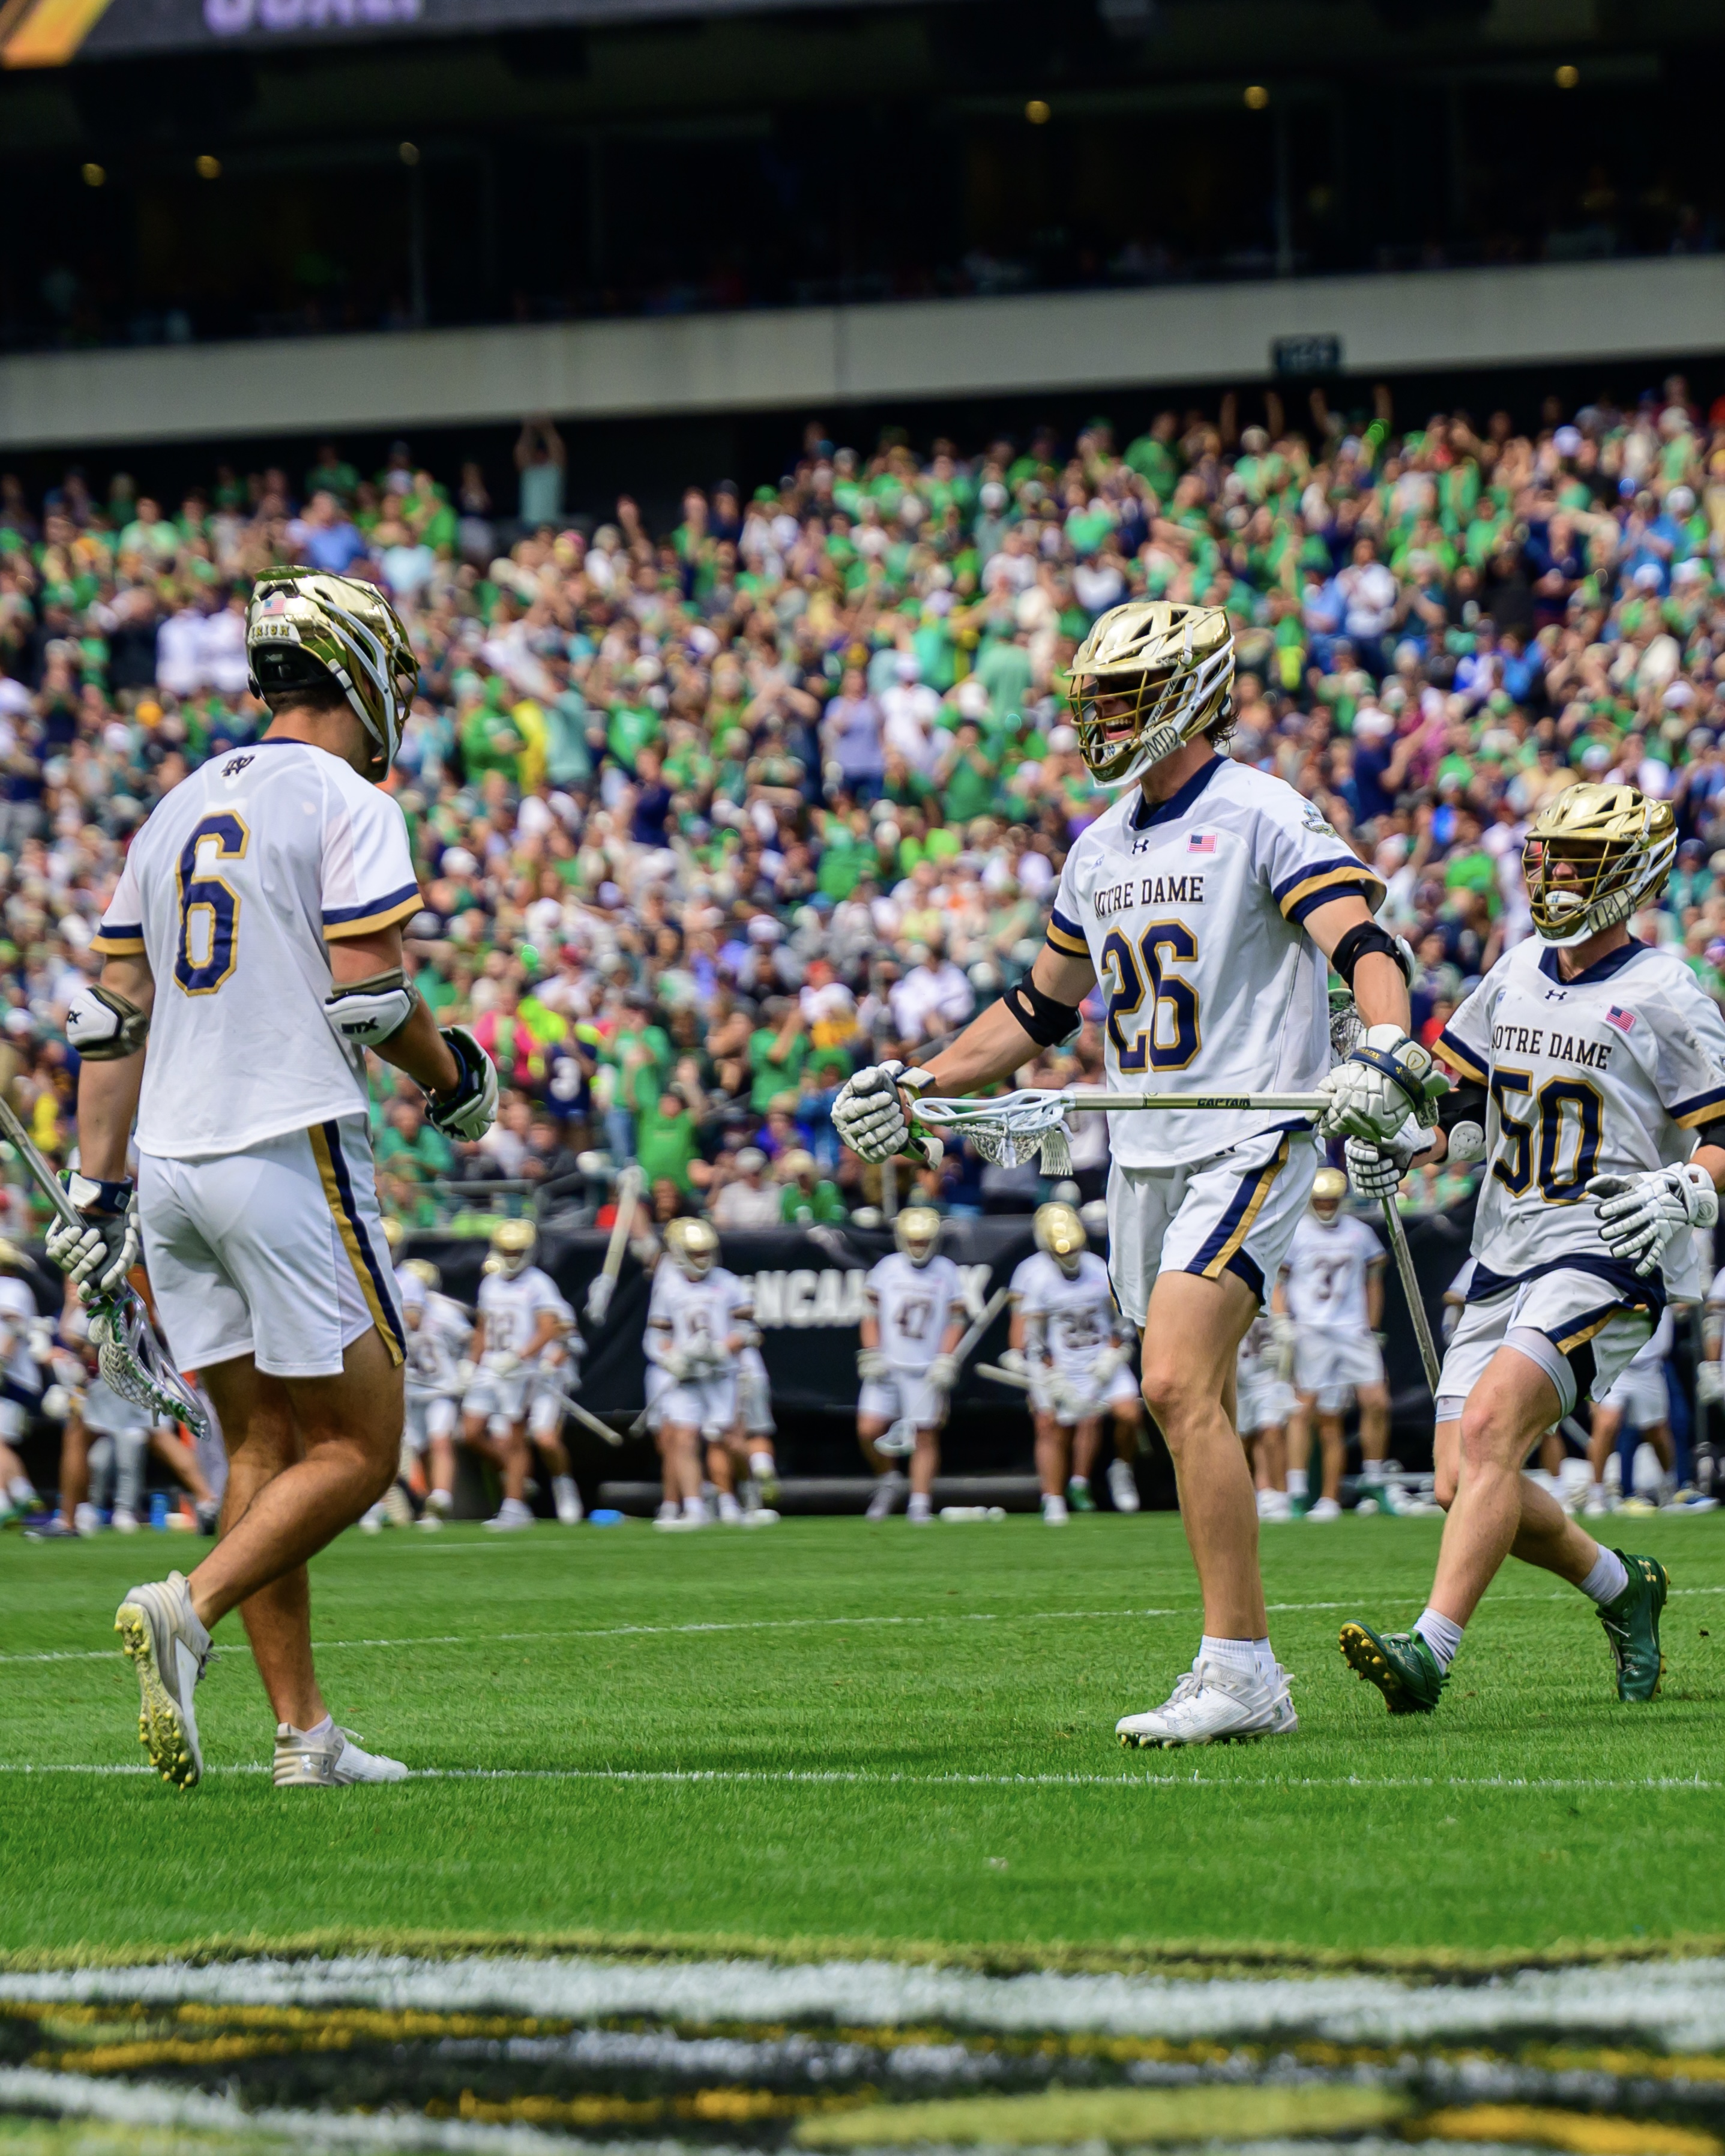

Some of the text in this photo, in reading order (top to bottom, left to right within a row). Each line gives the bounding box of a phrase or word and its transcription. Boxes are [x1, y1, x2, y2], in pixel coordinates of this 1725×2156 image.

[251, 624, 290, 638] IRISH
[173, 810, 250, 997] 6
[1141, 875, 1204, 905] DAME
[1101, 918, 1201, 1073] 26
[1548, 1032, 1613, 1070] DAME
[550, 1056, 581, 1101] 3
[1490, 1064, 1604, 1204] 50
[743, 1268, 874, 1329] NCAA
